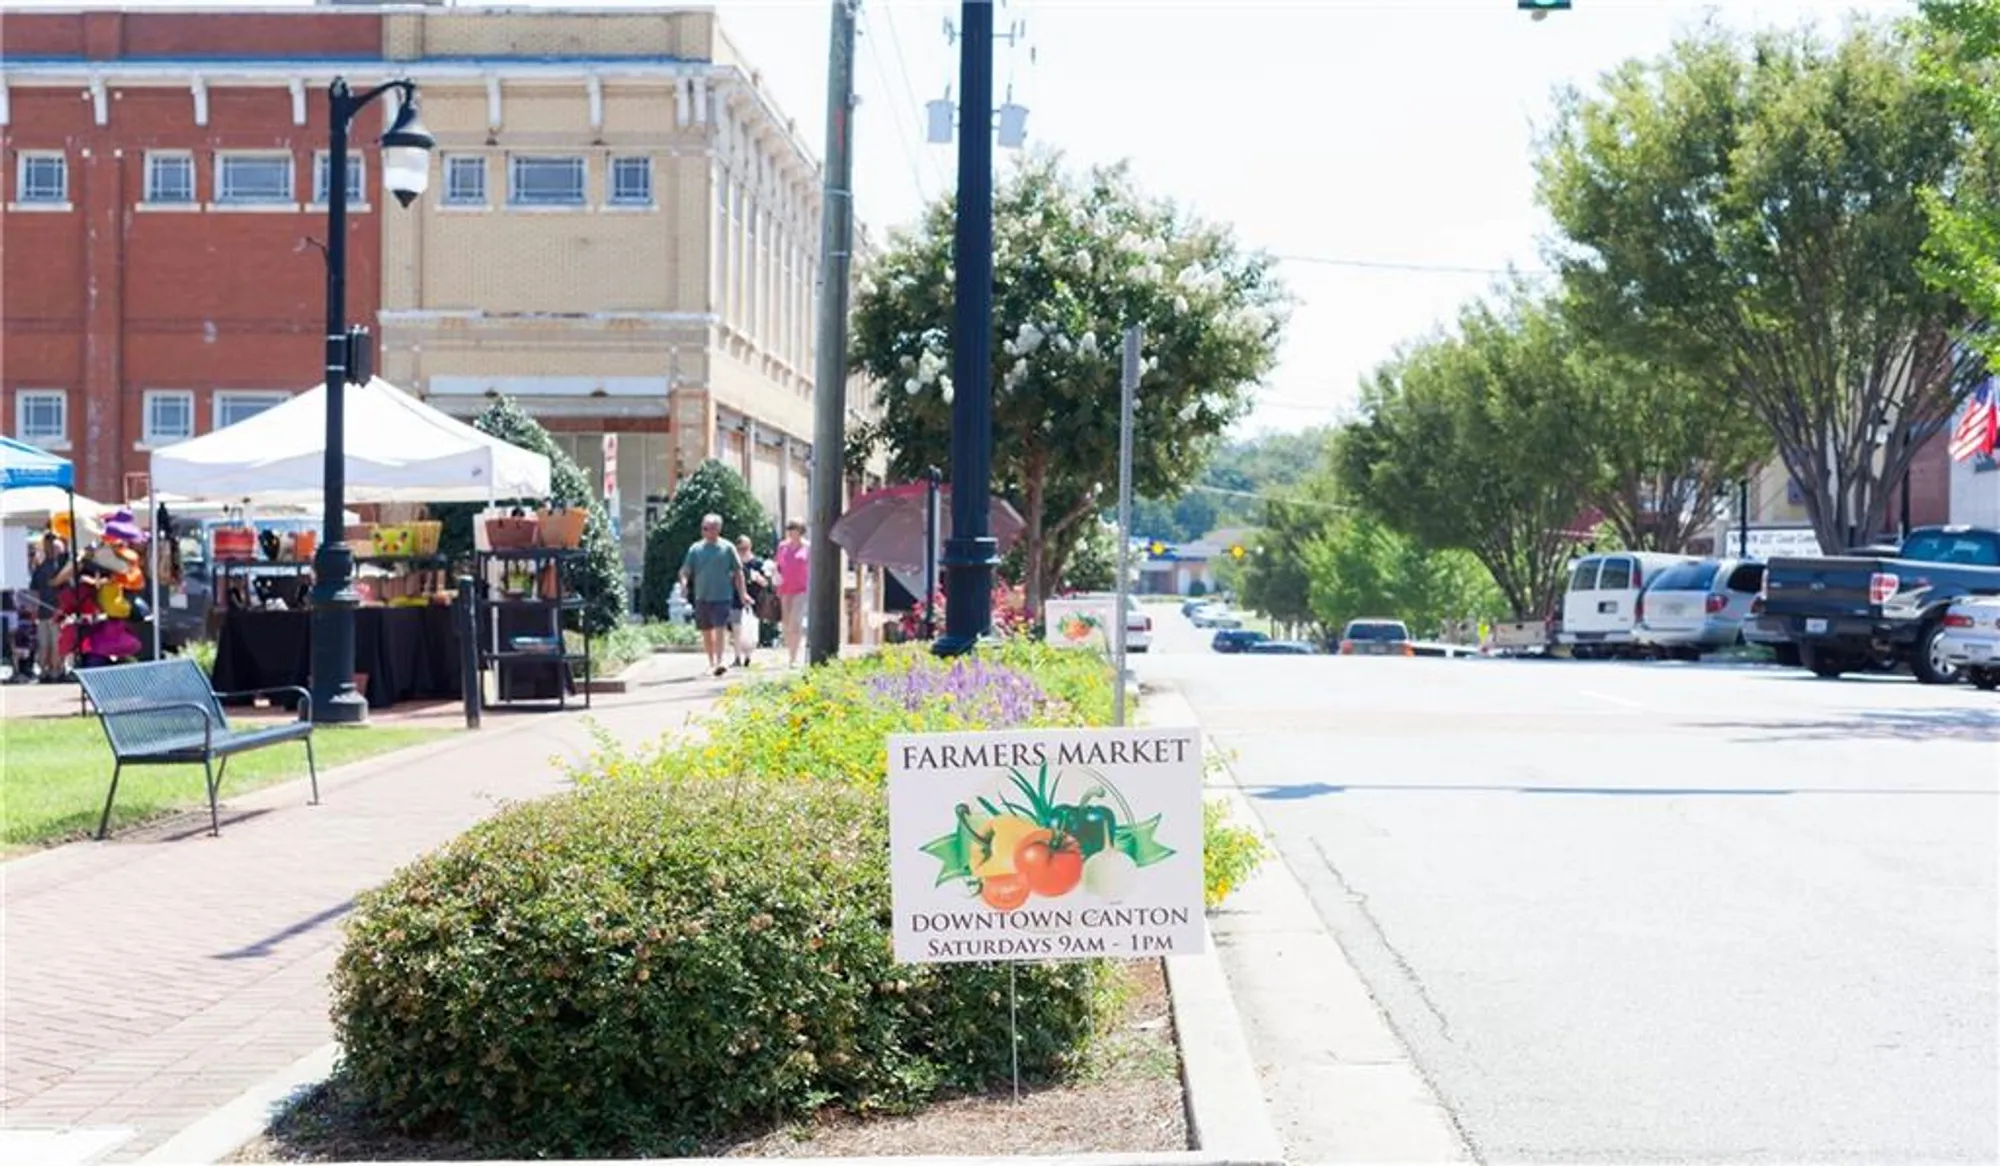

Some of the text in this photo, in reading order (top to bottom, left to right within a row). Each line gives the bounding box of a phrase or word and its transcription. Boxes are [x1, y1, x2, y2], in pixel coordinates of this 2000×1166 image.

[904, 738, 1190, 770] FARMERS MARKET
[911, 906, 1188, 933] DOWNTOWN CANTON
[928, 938, 1050, 958] SATURDAYS
[1058, 934, 1104, 953] 9AM
[1131, 933, 1173, 952] 1PM
